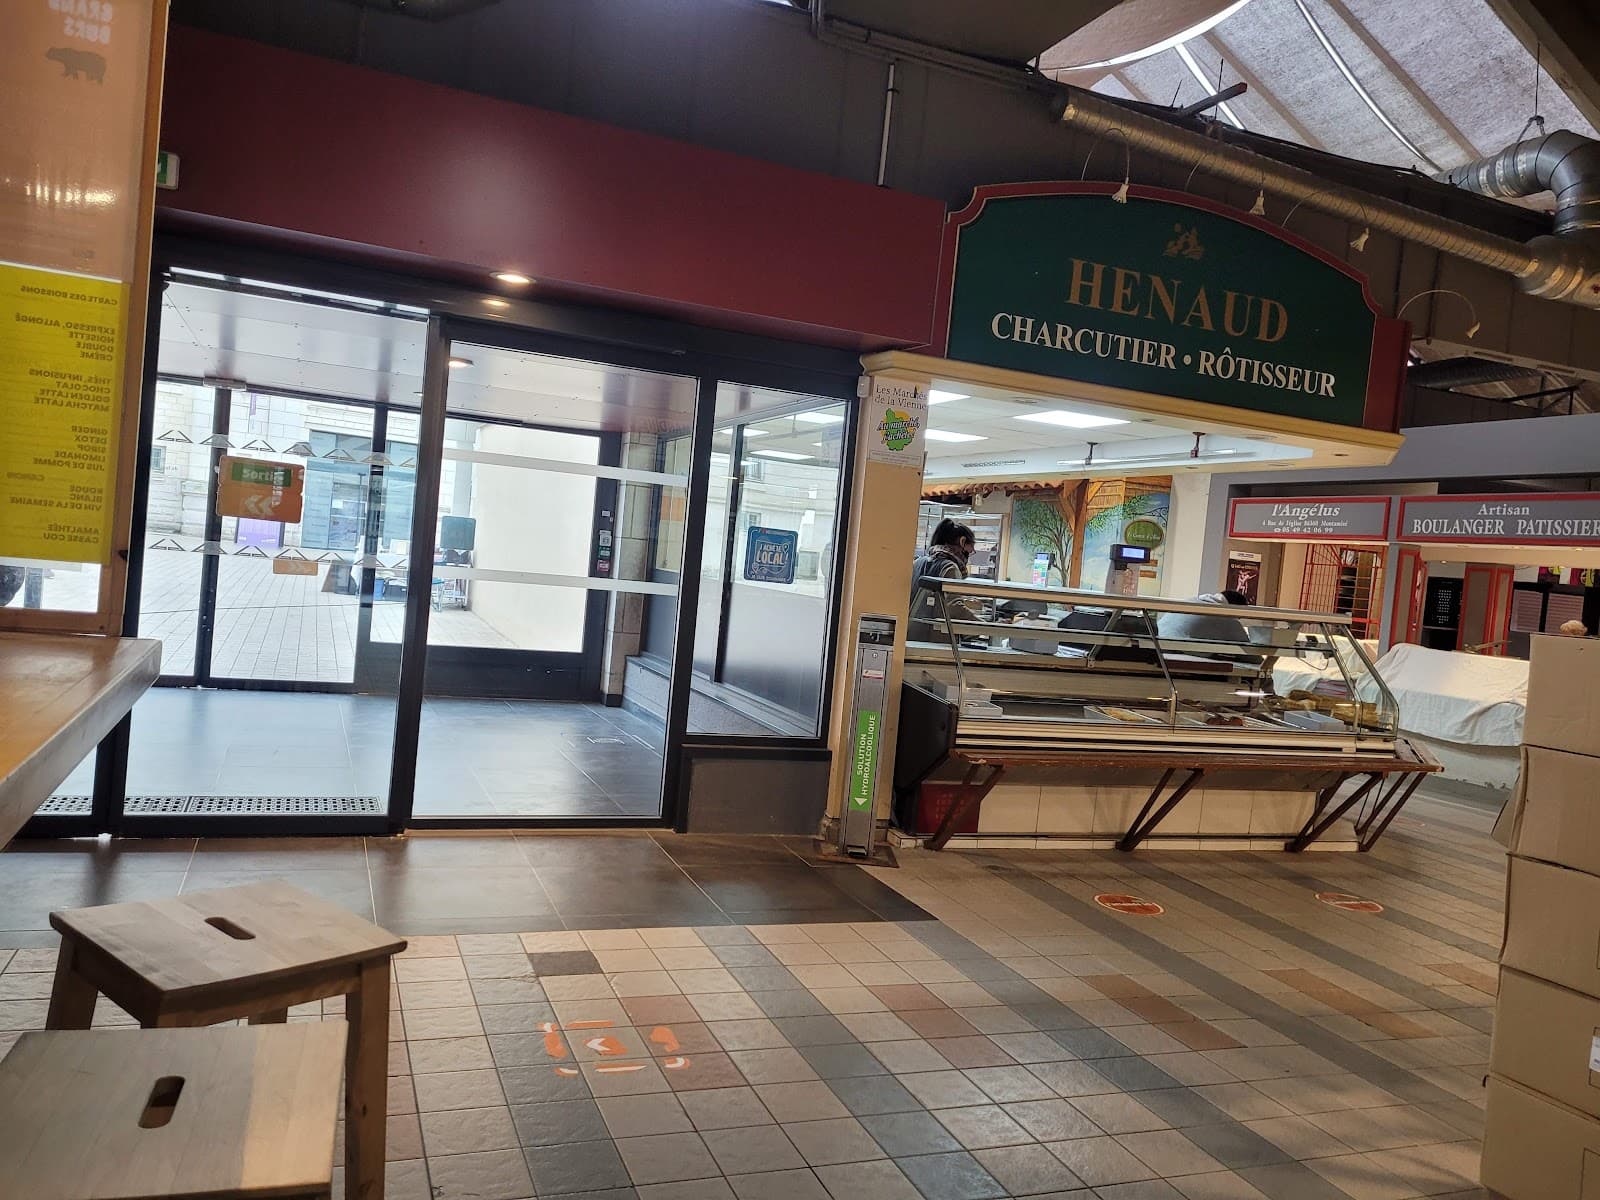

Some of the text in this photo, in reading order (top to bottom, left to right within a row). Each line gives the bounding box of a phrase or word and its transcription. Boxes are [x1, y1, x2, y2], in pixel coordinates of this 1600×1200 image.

[1065, 258, 1288, 342] HENAUD
[991, 312, 1335, 397] CHARCUTIER RÔTISSEUR
[876, 384, 891, 394] Les
[875, 394, 927, 409] de la Vienne
[1272, 503, 1340, 520] l'Angélus
[1478, 504, 1530, 516] Artisan
[1412, 519, 1600, 536] BOULANGER PATISSIER
[756, 551, 784, 564] LOCAL
[856, 733, 867, 776] SOLUTION
[861, 715, 876, 796] HYDROALCOOLIQUE
